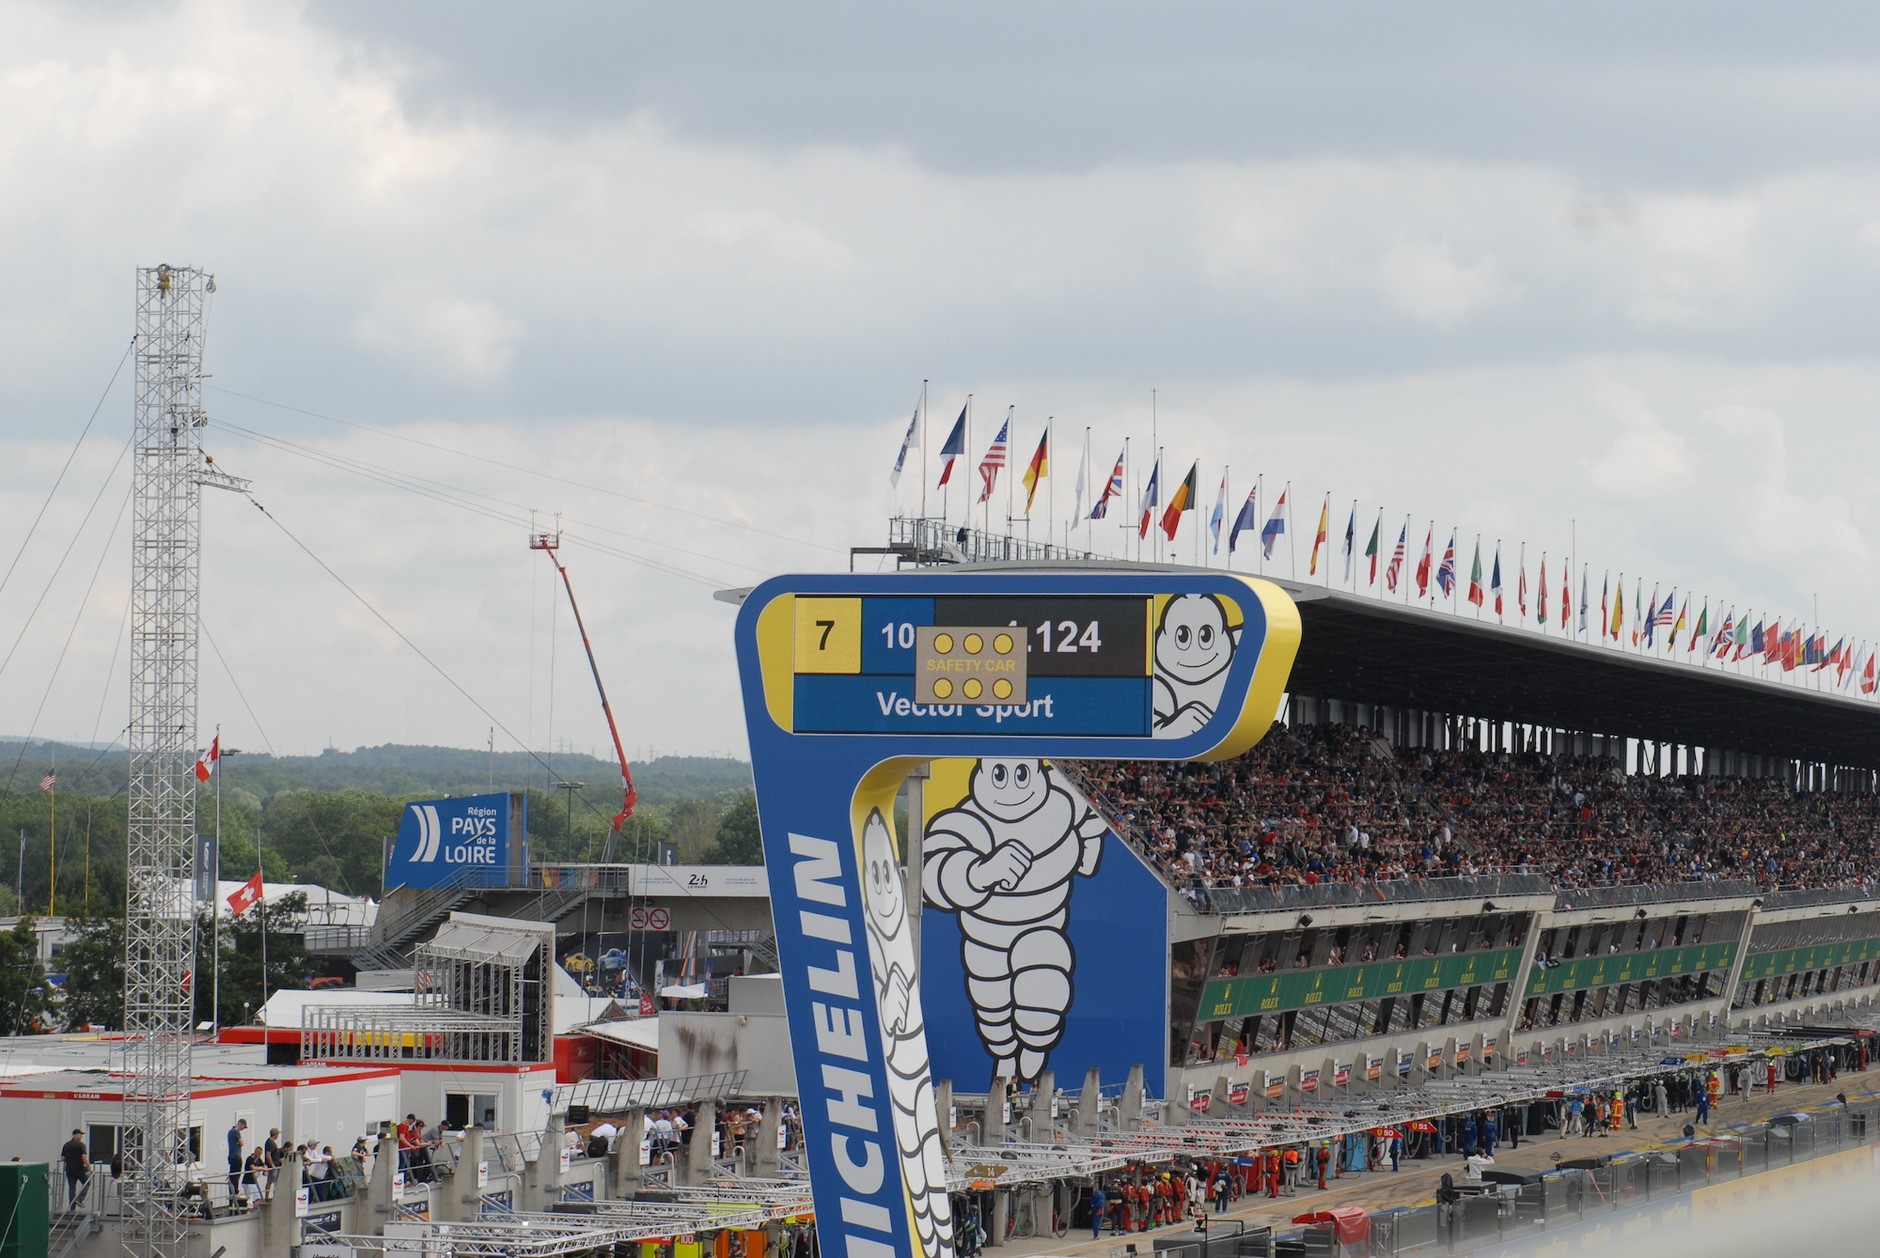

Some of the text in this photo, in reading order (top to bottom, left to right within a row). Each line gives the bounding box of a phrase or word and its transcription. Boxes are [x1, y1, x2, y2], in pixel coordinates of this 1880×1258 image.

[815, 620, 835, 651] 7
[881, 622, 915, 649] 10
[1008, 620, 1102, 653] .124
[926, 659, 1016, 672] SAFETY CAR
[468, 807, 497, 817] Région
[452, 817, 496, 835] PAYS
[476, 836, 496, 845] de la
[445, 846, 496, 863] LOIRE
[1213, 1003, 1232, 1015] ROLEX
